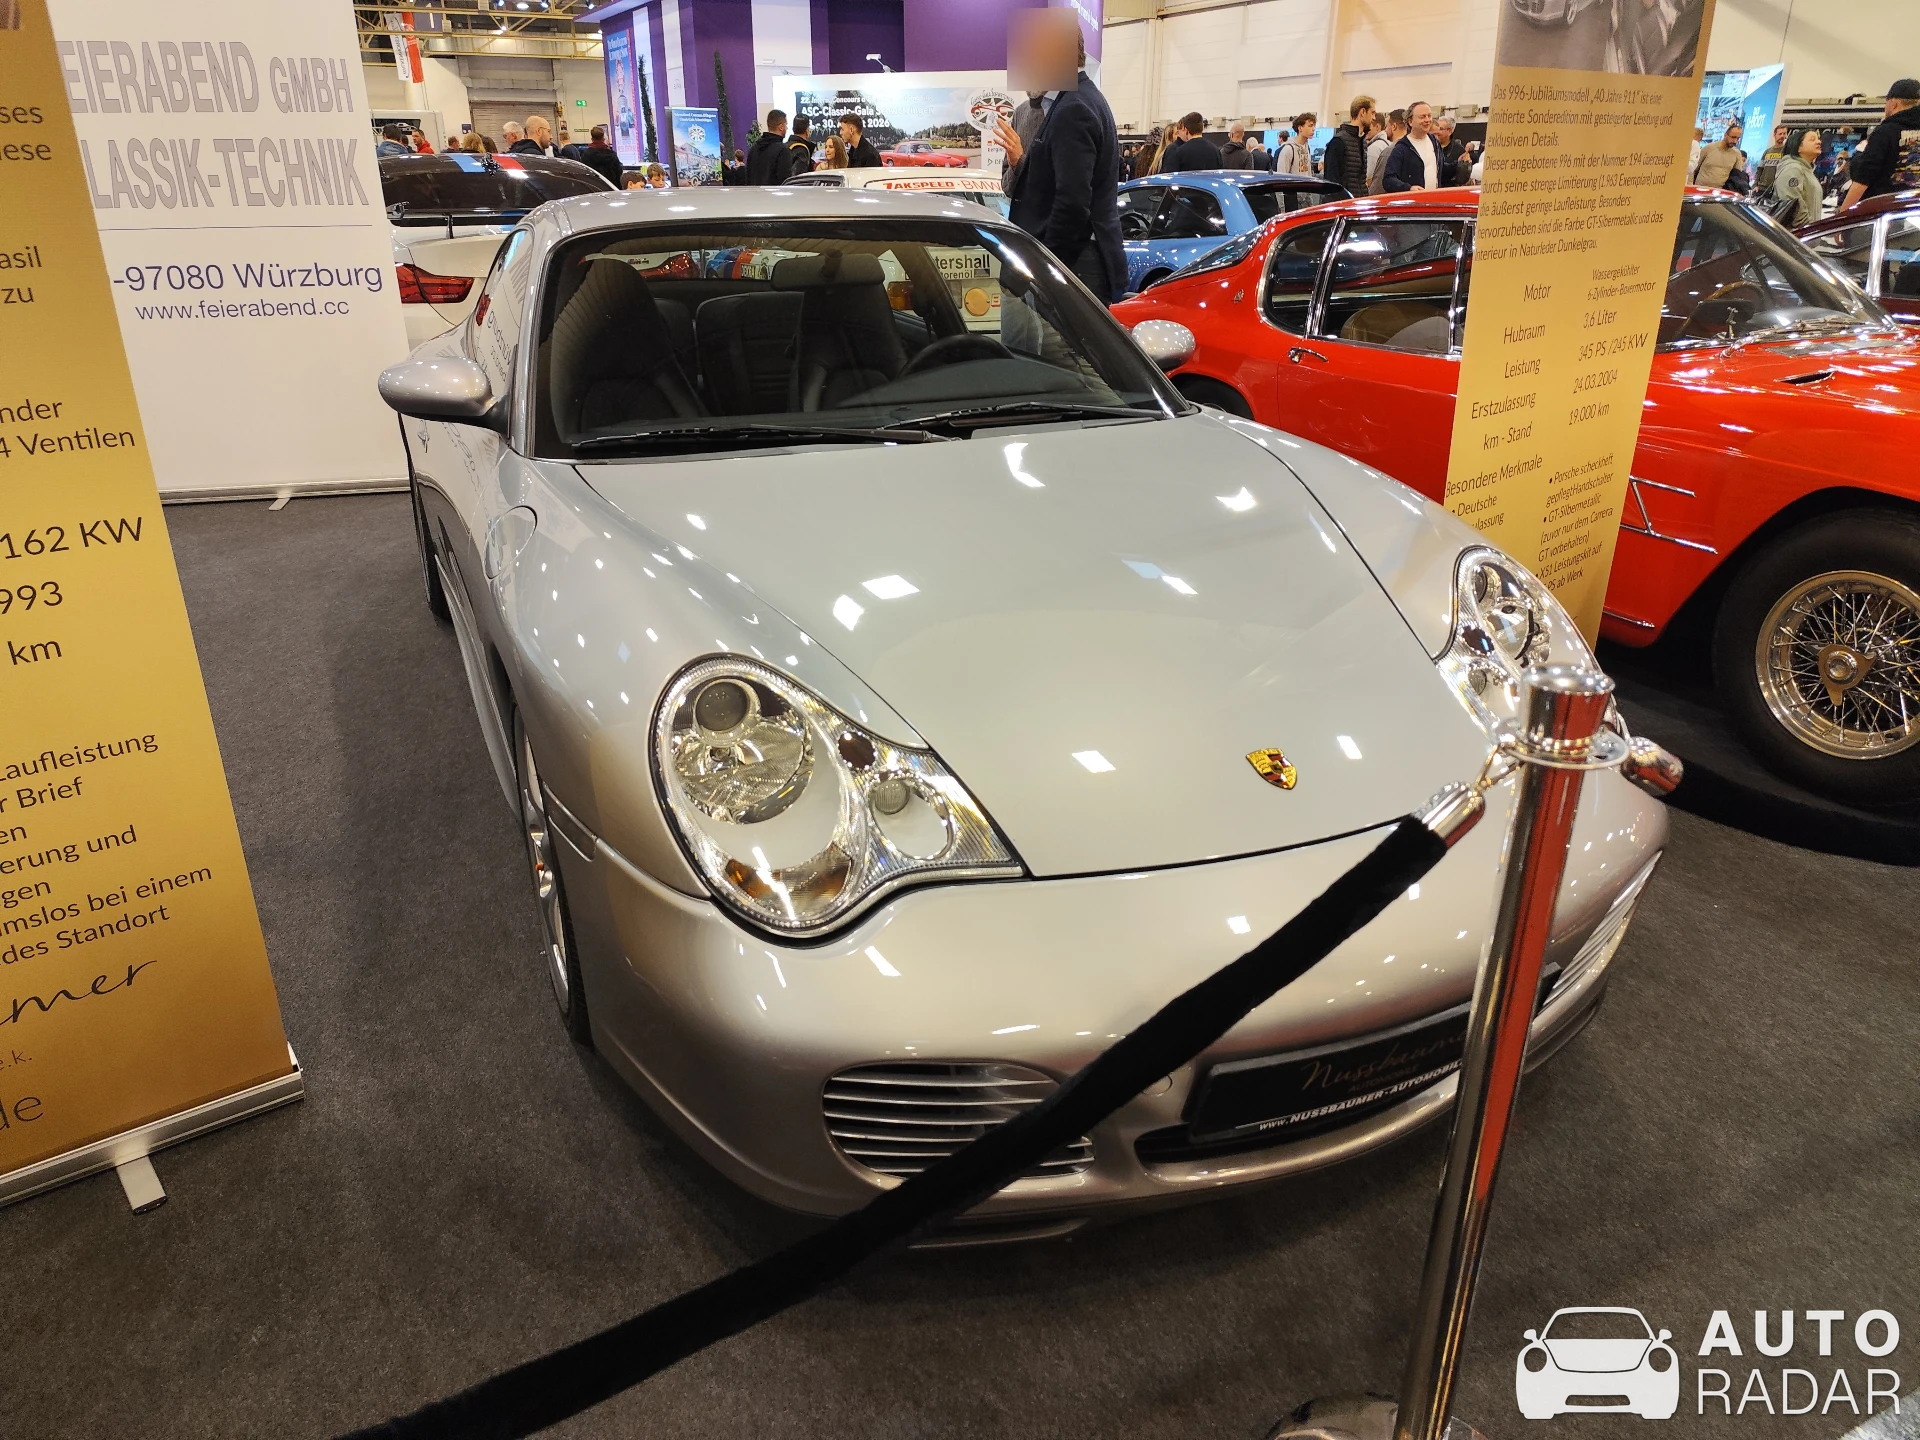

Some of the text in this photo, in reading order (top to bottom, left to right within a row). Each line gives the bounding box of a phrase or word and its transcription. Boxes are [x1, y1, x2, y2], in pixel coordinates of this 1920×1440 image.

[270, 57, 354, 114] GMBH
[867, 118, 890, 128] 2026
[1527, 109, 1578, 125] Sonderedition
[1580, 110, 1592, 124] mit
[1634, 112, 1658, 128] Leistung
[1660, 113, 1673, 125] und
[1488, 132, 1528, 147] exklusiven
[0, 143, 52, 161] ese
[1486, 156, 1509, 171] Dieser
[1511, 155, 1558, 172] angebotene
[1560, 154, 1571, 168] 996
[1573, 154, 1586, 168] mit
[1588, 153, 1600, 167] der
[1601, 153, 1627, 167] Nummer
[80, 137, 369, 209] LASSIK-TECHNIK
[1505, 178, 1527, 192] seine
[1530, 179, 1556, 193] strenge
[1558, 175, 1597, 191] Limitierung
[1653, 171, 1667, 184] und
[1491, 201, 1524, 216] äußerst
[1526, 199, 1552, 216] geringe
[1599, 193, 1631, 208] Besonders
[1538, 219, 1552, 234] sind
[1553, 219, 1562, 232] die
[1564, 217, 1584, 231] Farbe
[1639, 211, 1650, 224] und
[1651, 211, 1664, 223] das
[1510, 244, 1517, 258] in
[233, 263, 383, 292] Würzburg
[1592, 264, 1640, 281] Wassergekühlter
[1, 287, 35, 304] zu
[1524, 283, 1551, 302] Motor
[135, 297, 350, 320] www.feierabend.cc
[1597, 309, 1617, 326] Liter
[1504, 324, 1545, 344] Hubraum
[1595, 340, 1607, 357] PS
[1628, 333, 1649, 350] KW
[1504, 358, 1541, 379] Leistung
[1573, 369, 1618, 394] 24.03.2004
[0, 399, 62, 423] nder
[1471, 391, 1536, 419] Erstzulassung
[1568, 402, 1610, 426] 19.000 km
[16, 427, 136, 456] Ventilen
[1483, 434, 1499, 451] km
[1507, 421, 1533, 444] Stand
[1446, 454, 1543, 498] Besondere Merkmale
[1553, 466, 1579, 484] Porsche
[1457, 494, 1497, 517] Deutsche
[79, 516, 143, 548] KW
[1561, 522, 1574, 535] nur
[1575, 517, 1589, 530] dem
[1591, 508, 1613, 523] Carrera
[1538, 547, 1550, 562] GT
[1554, 547, 1591, 573] Leistungskit
[1557, 575, 1565, 588] ab
[1567, 566, 1584, 583] Werk
[0, 581, 63, 615] 993
[7, 638, 62, 666] km
[0, 734, 159, 781] aufleistung
[16, 776, 83, 809] Brief
[0, 824, 137, 874] erung und
[0, 867, 212, 937] mslos bei einem
[1, 881, 51, 909] gen
[56, 905, 170, 949] Standort
